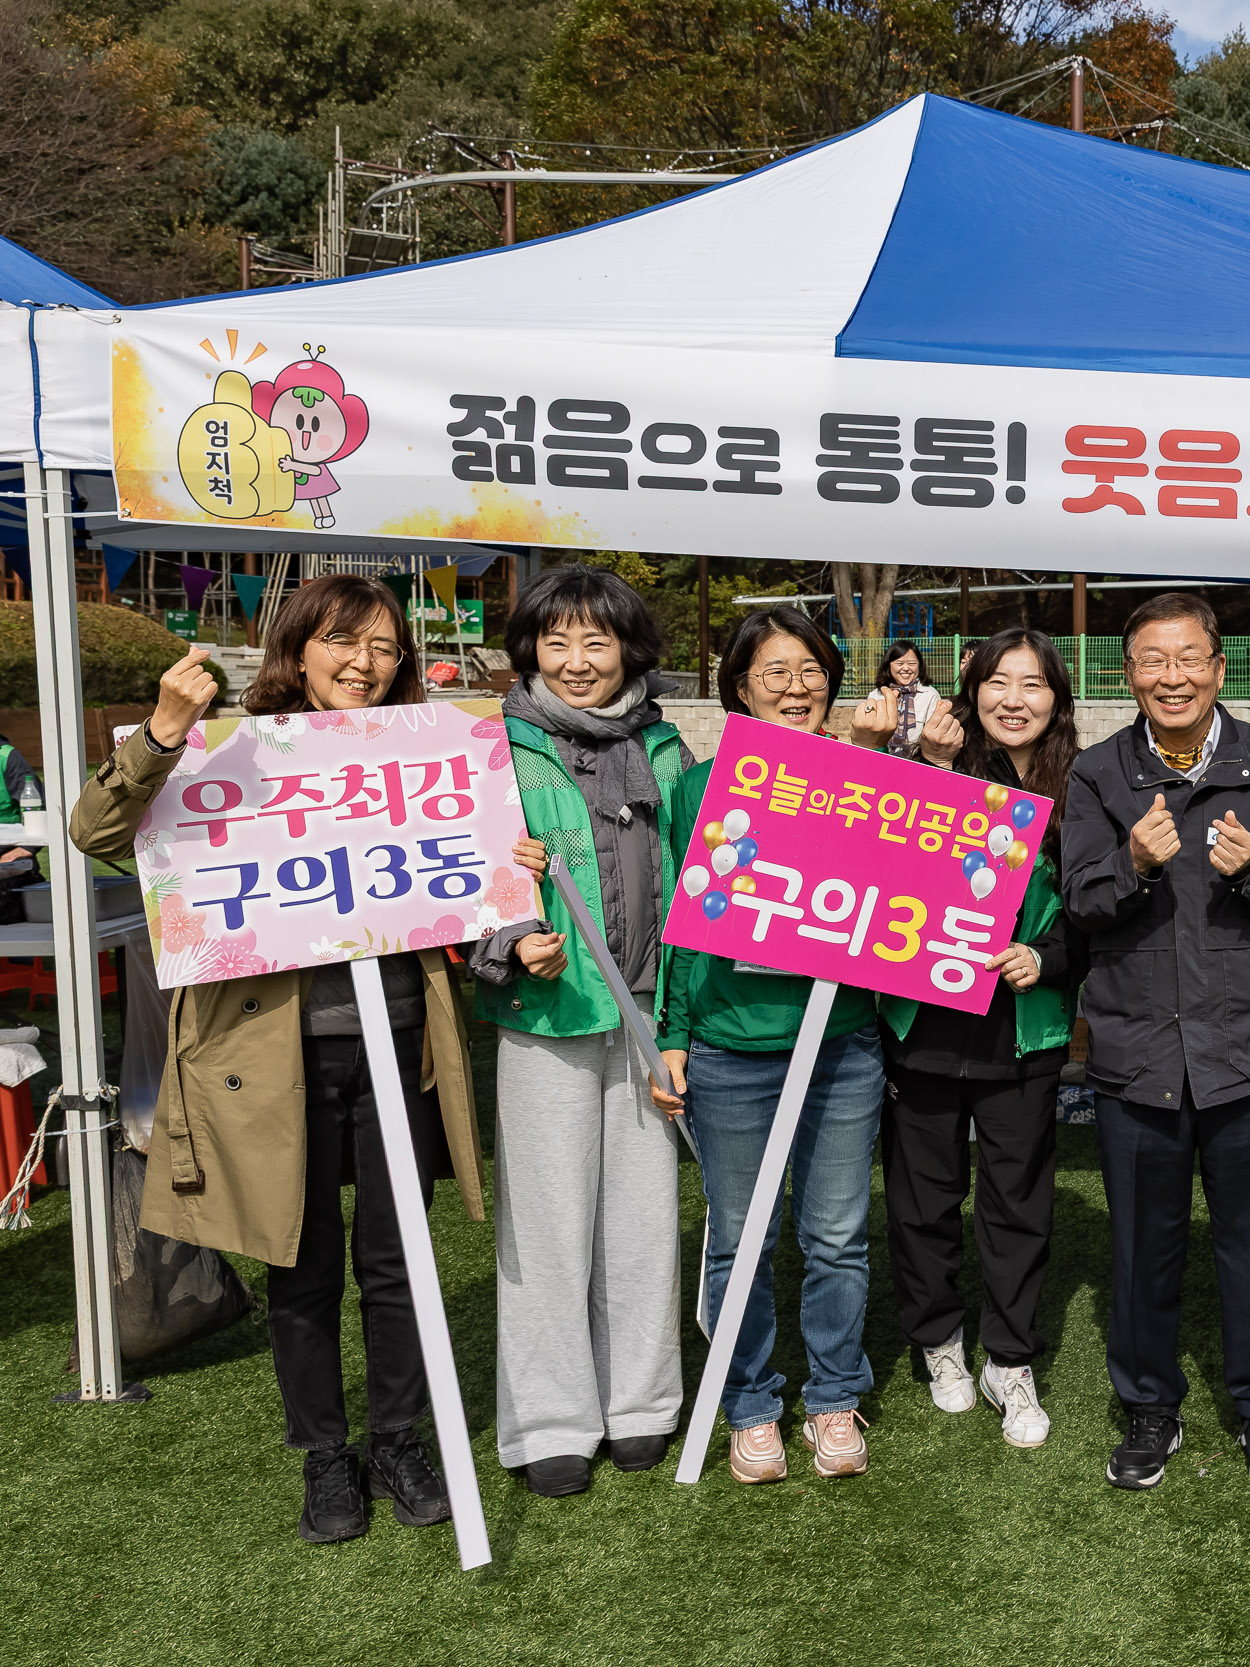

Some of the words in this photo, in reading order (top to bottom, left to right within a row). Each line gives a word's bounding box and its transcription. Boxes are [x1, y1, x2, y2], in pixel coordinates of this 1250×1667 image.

[205, 420, 234, 506] 엄지척
[446, 393, 784, 497] 젊음으로
[815, 412, 1027, 509] 통통!
[177, 754, 479, 847] 우주최강
[192, 834, 487, 930] 구의3동
[731, 859, 998, 993] 구의3동
